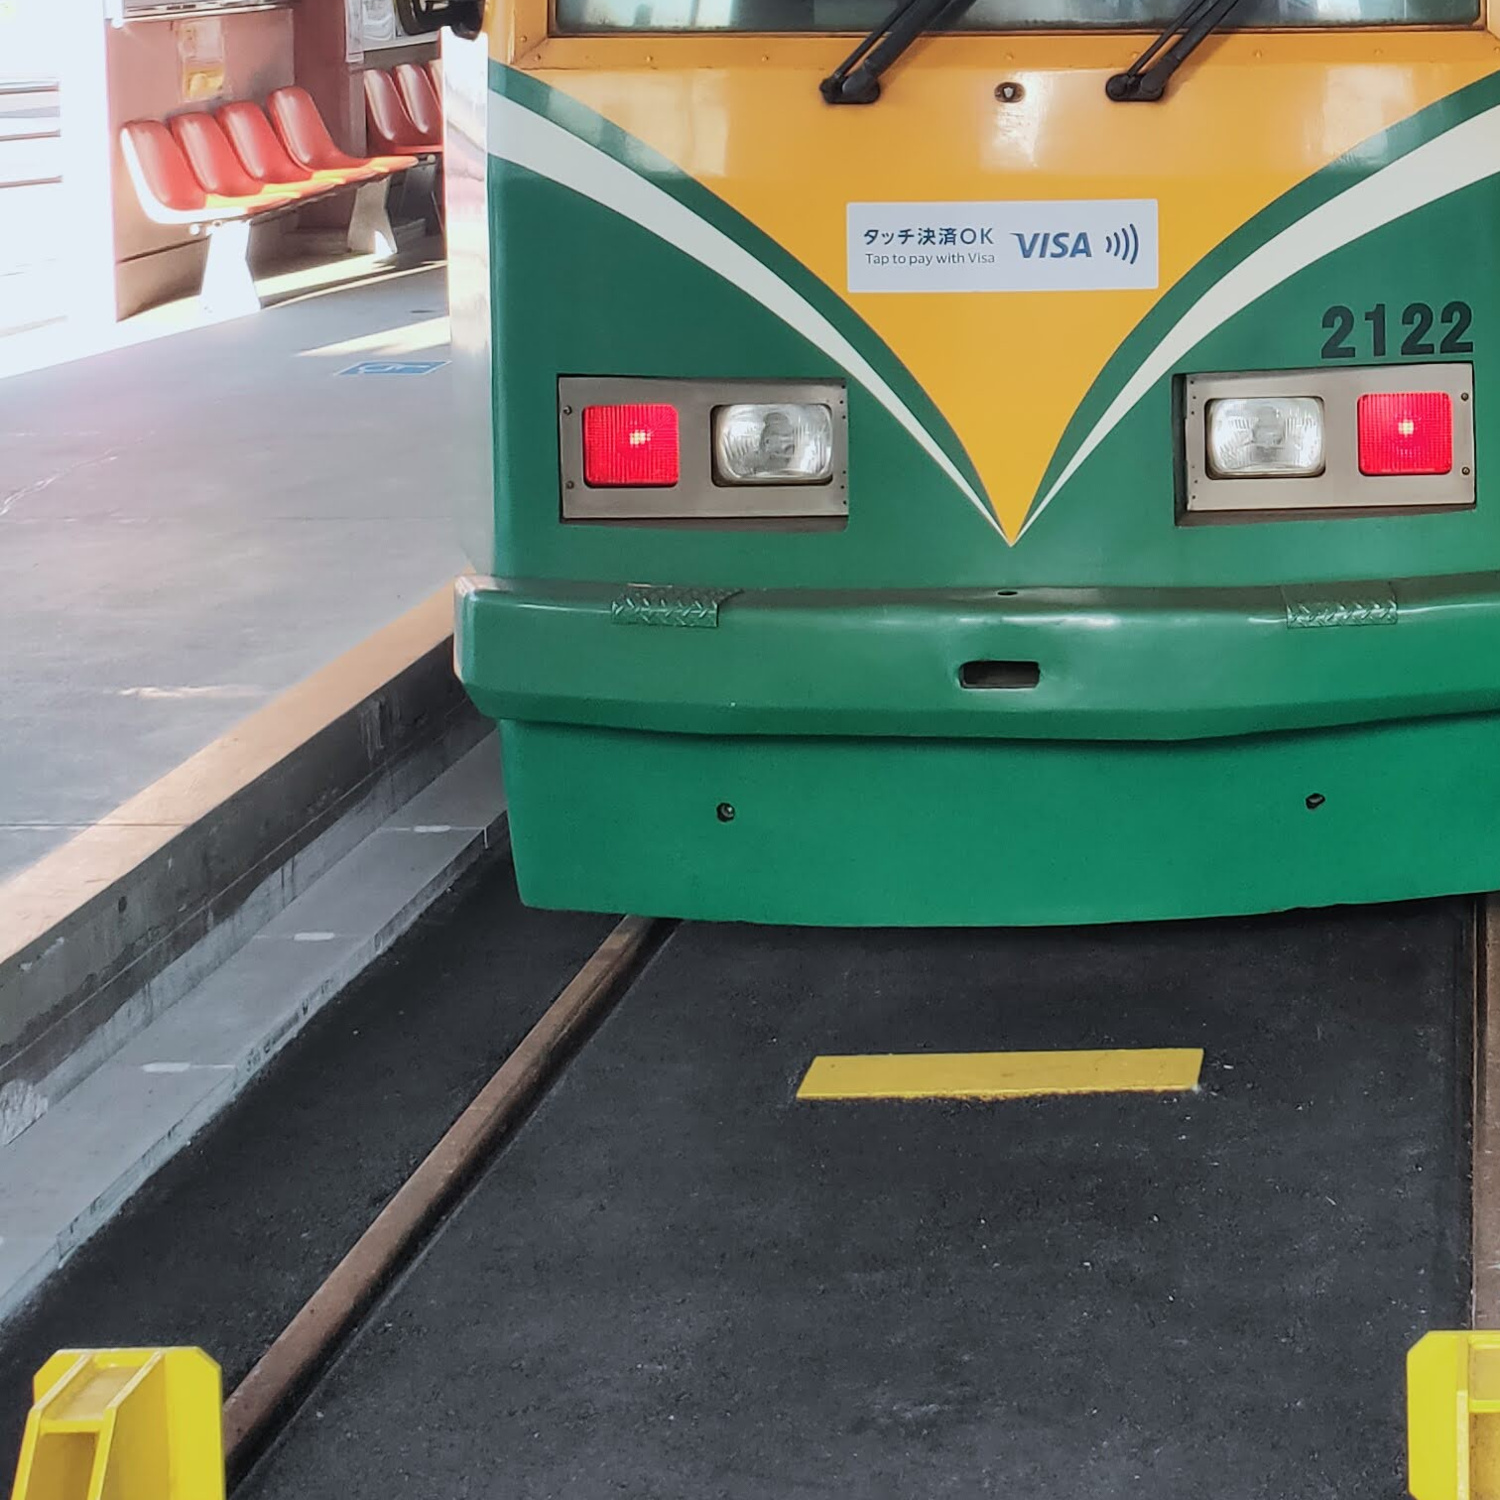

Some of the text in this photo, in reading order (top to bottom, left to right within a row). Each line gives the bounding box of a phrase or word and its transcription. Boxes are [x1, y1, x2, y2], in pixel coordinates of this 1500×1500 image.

[863, 227, 994, 246] タッチ決済OK
[1009, 232, 1093, 259] VISA
[865, 252, 995, 267] Tap to pay with Visa
[1321, 301, 1474, 359] 2122
